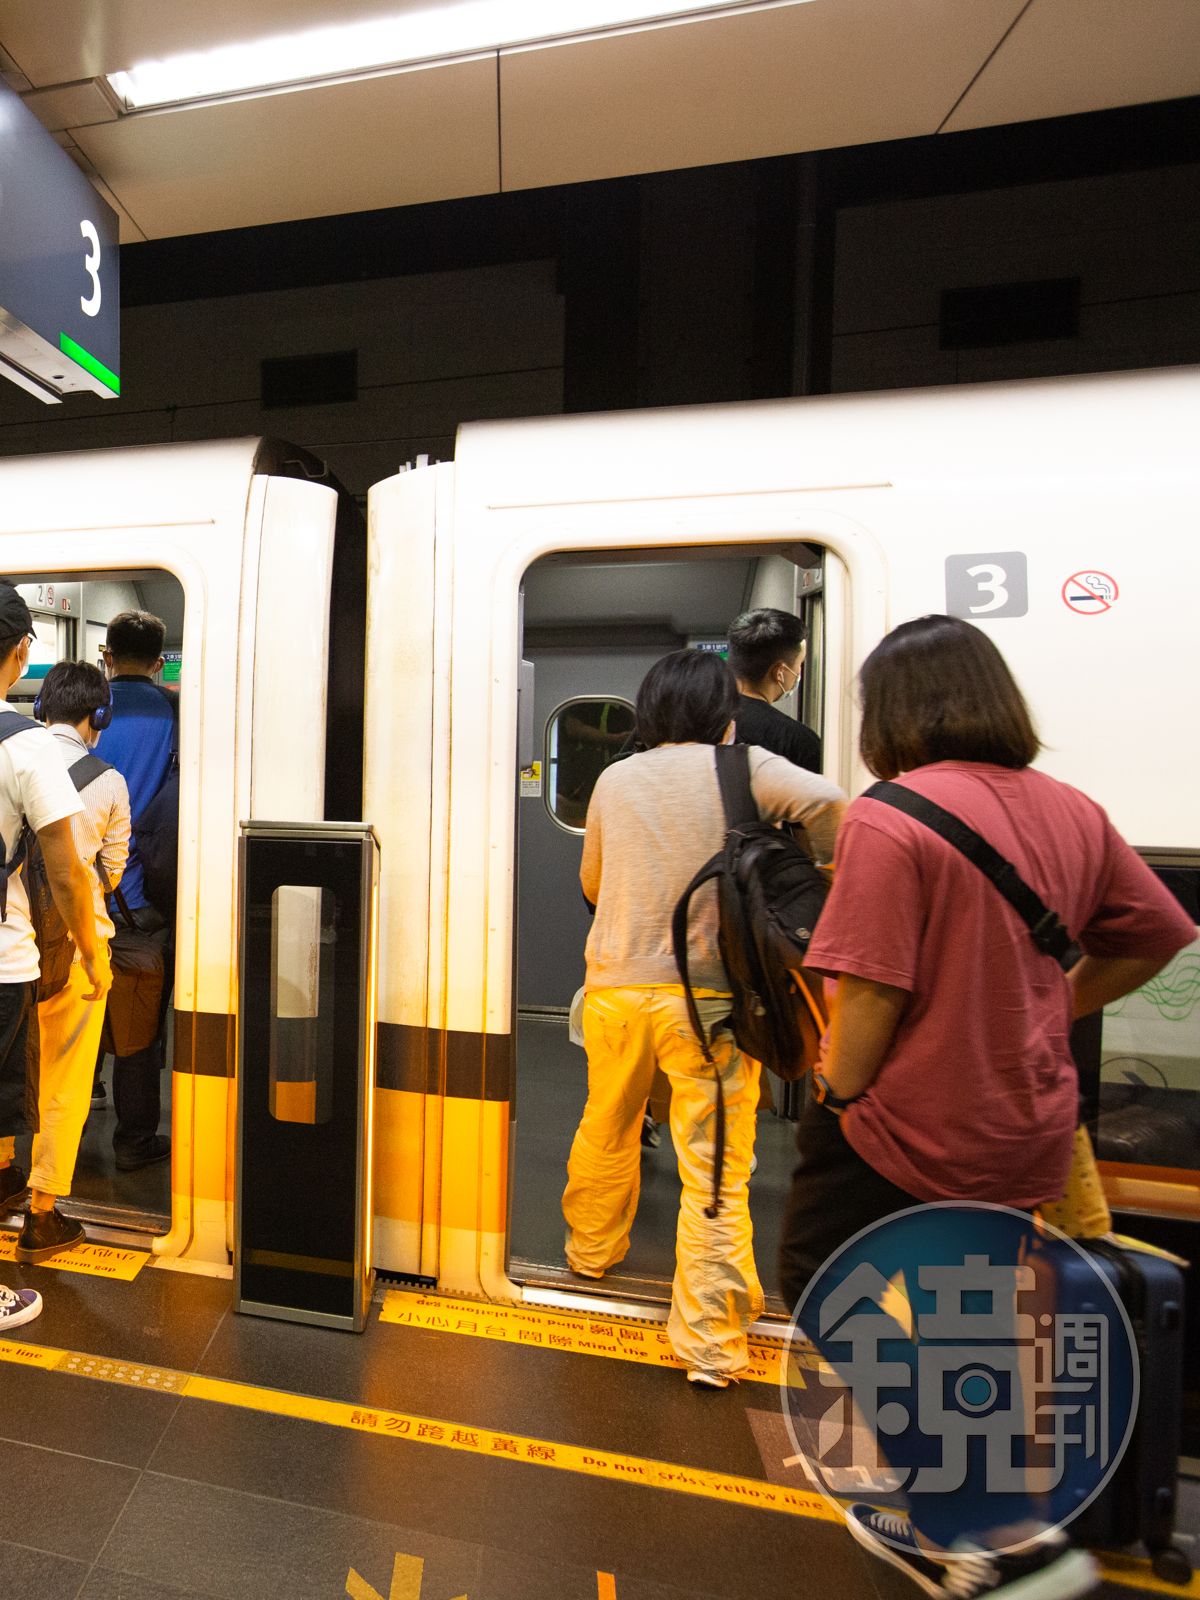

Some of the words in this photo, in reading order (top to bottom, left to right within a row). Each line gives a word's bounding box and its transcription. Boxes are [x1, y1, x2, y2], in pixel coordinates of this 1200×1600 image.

[80, 220, 101, 317] 3
[966, 564, 1008, 613] 3
[416, 1299, 442, 1308] gap
[16, 1348, 44, 1360] line
[398, 1312, 573, 1347] 小心月台間隙
[578, 1340, 617, 1353] Mind
[350, 1410, 557, 1462] 請勿跨越黃線
[583, 1455, 607, 1468] Do
[614, 1463, 647, 1475] not
[712, 1483, 776, 1501] yellow
